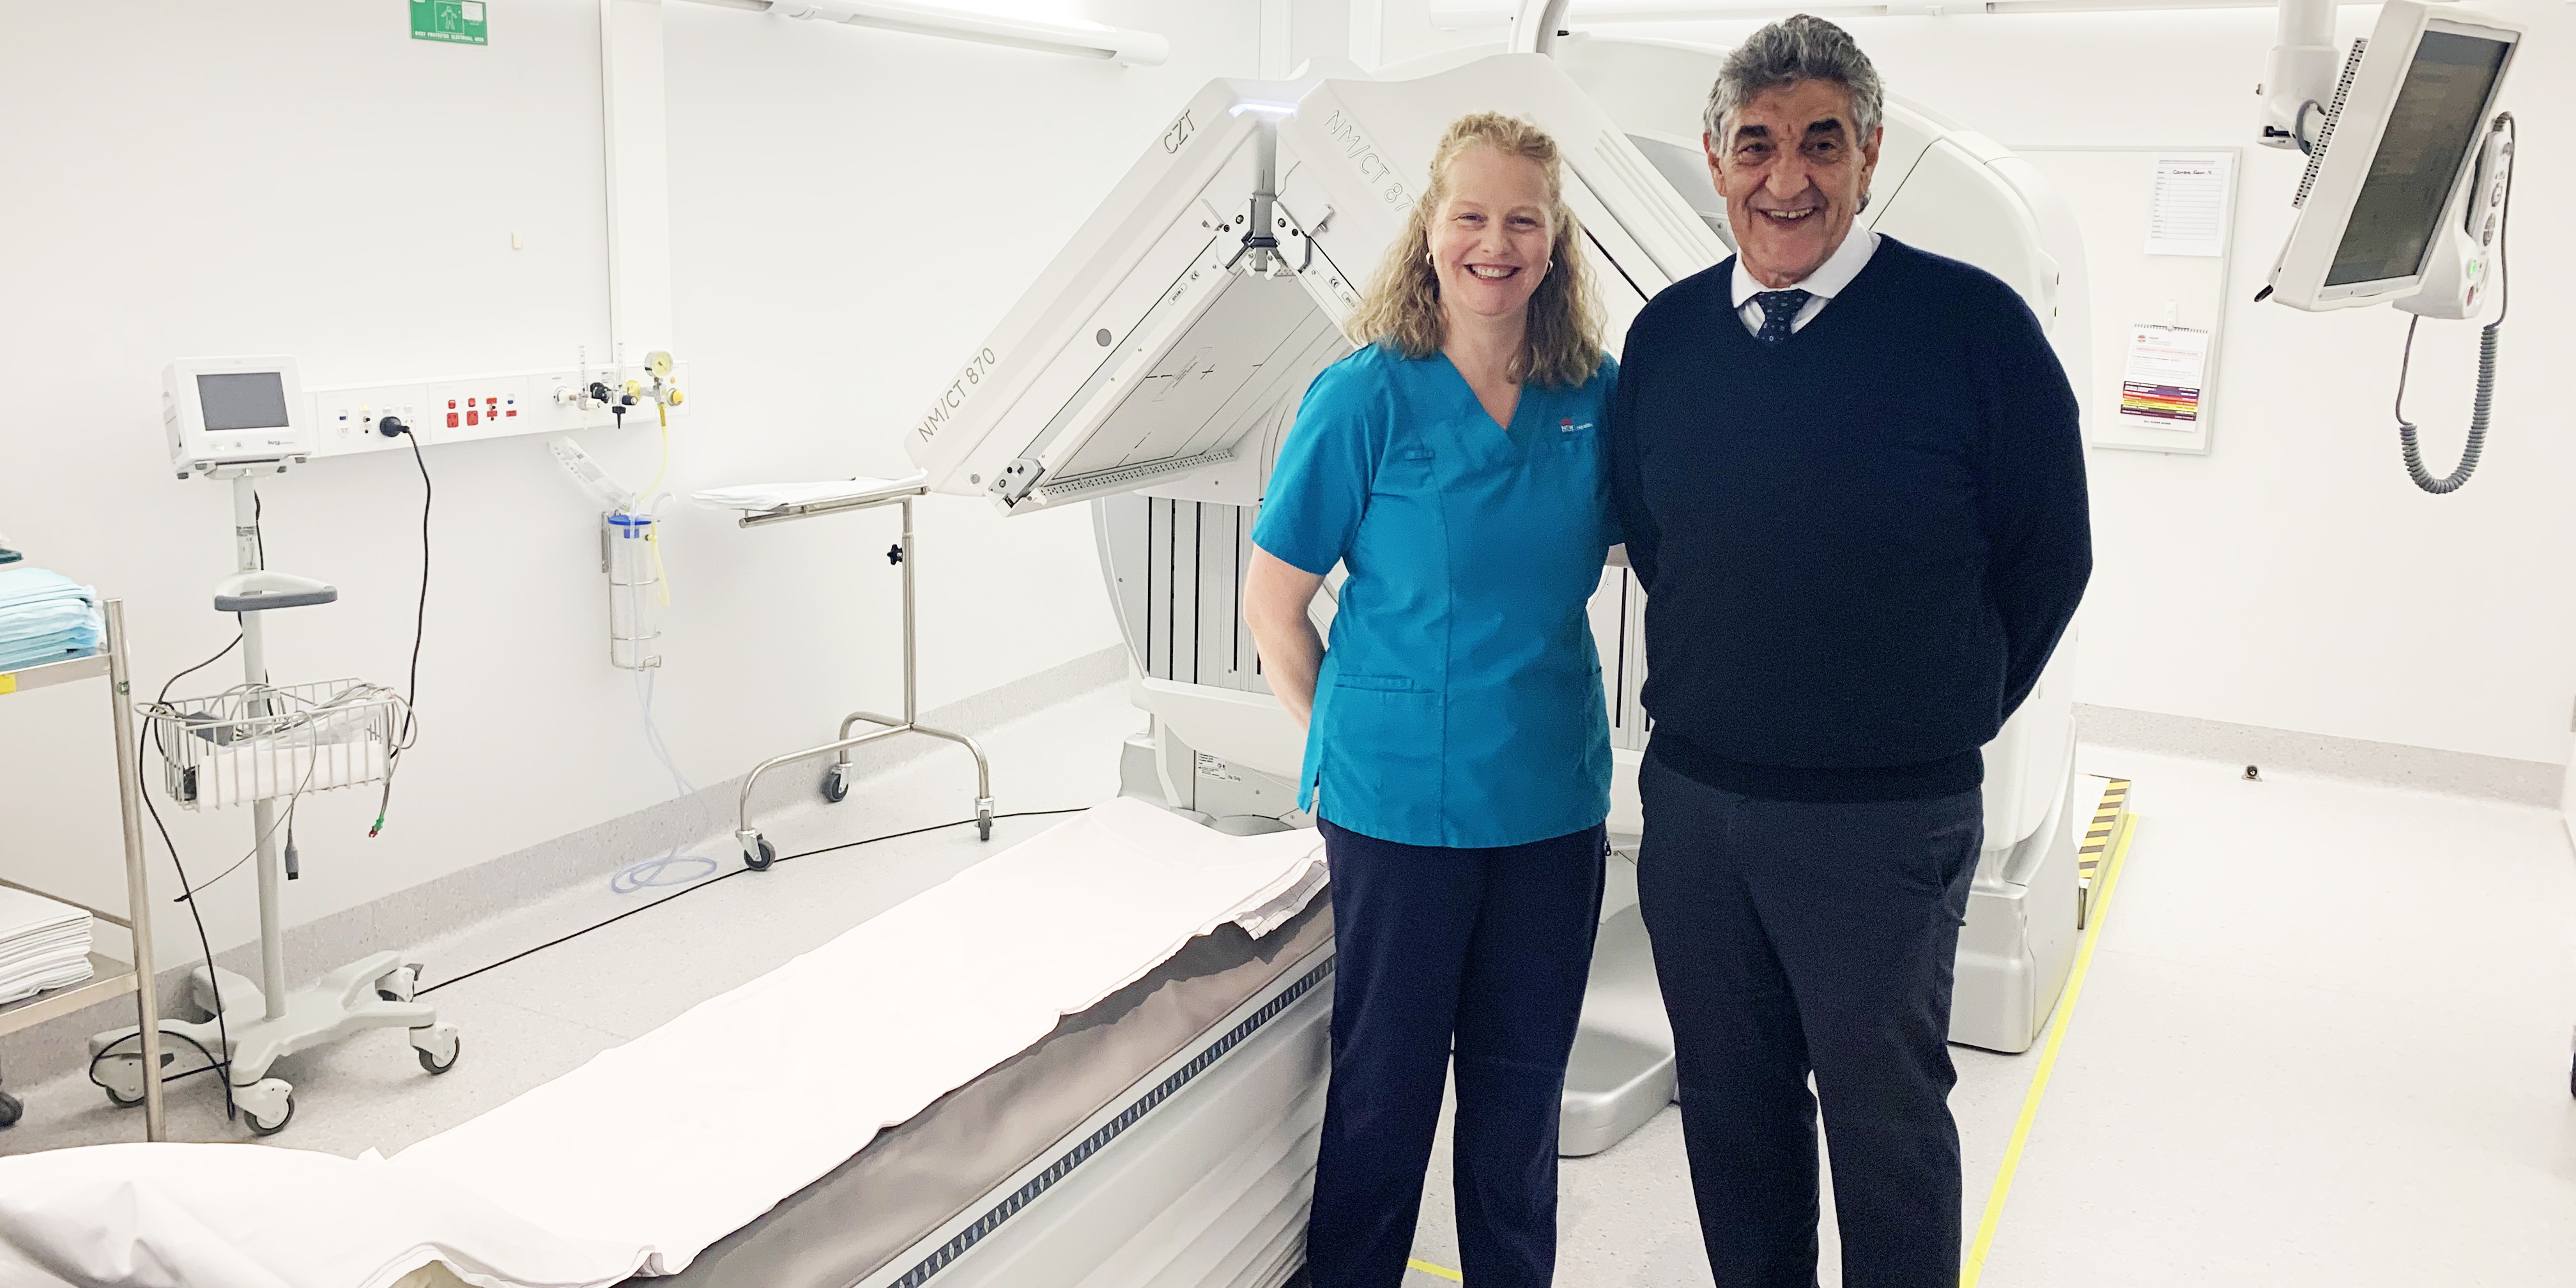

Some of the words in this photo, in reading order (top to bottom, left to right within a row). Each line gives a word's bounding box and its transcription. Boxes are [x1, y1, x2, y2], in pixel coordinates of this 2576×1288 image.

[1163, 109, 1194, 154] CZT
[1323, 110, 1390, 183] NM/CT
[1384, 183, 1414, 217] 87
[918, 379, 966, 442] NM/CT
[966, 348, 995, 385] 870
